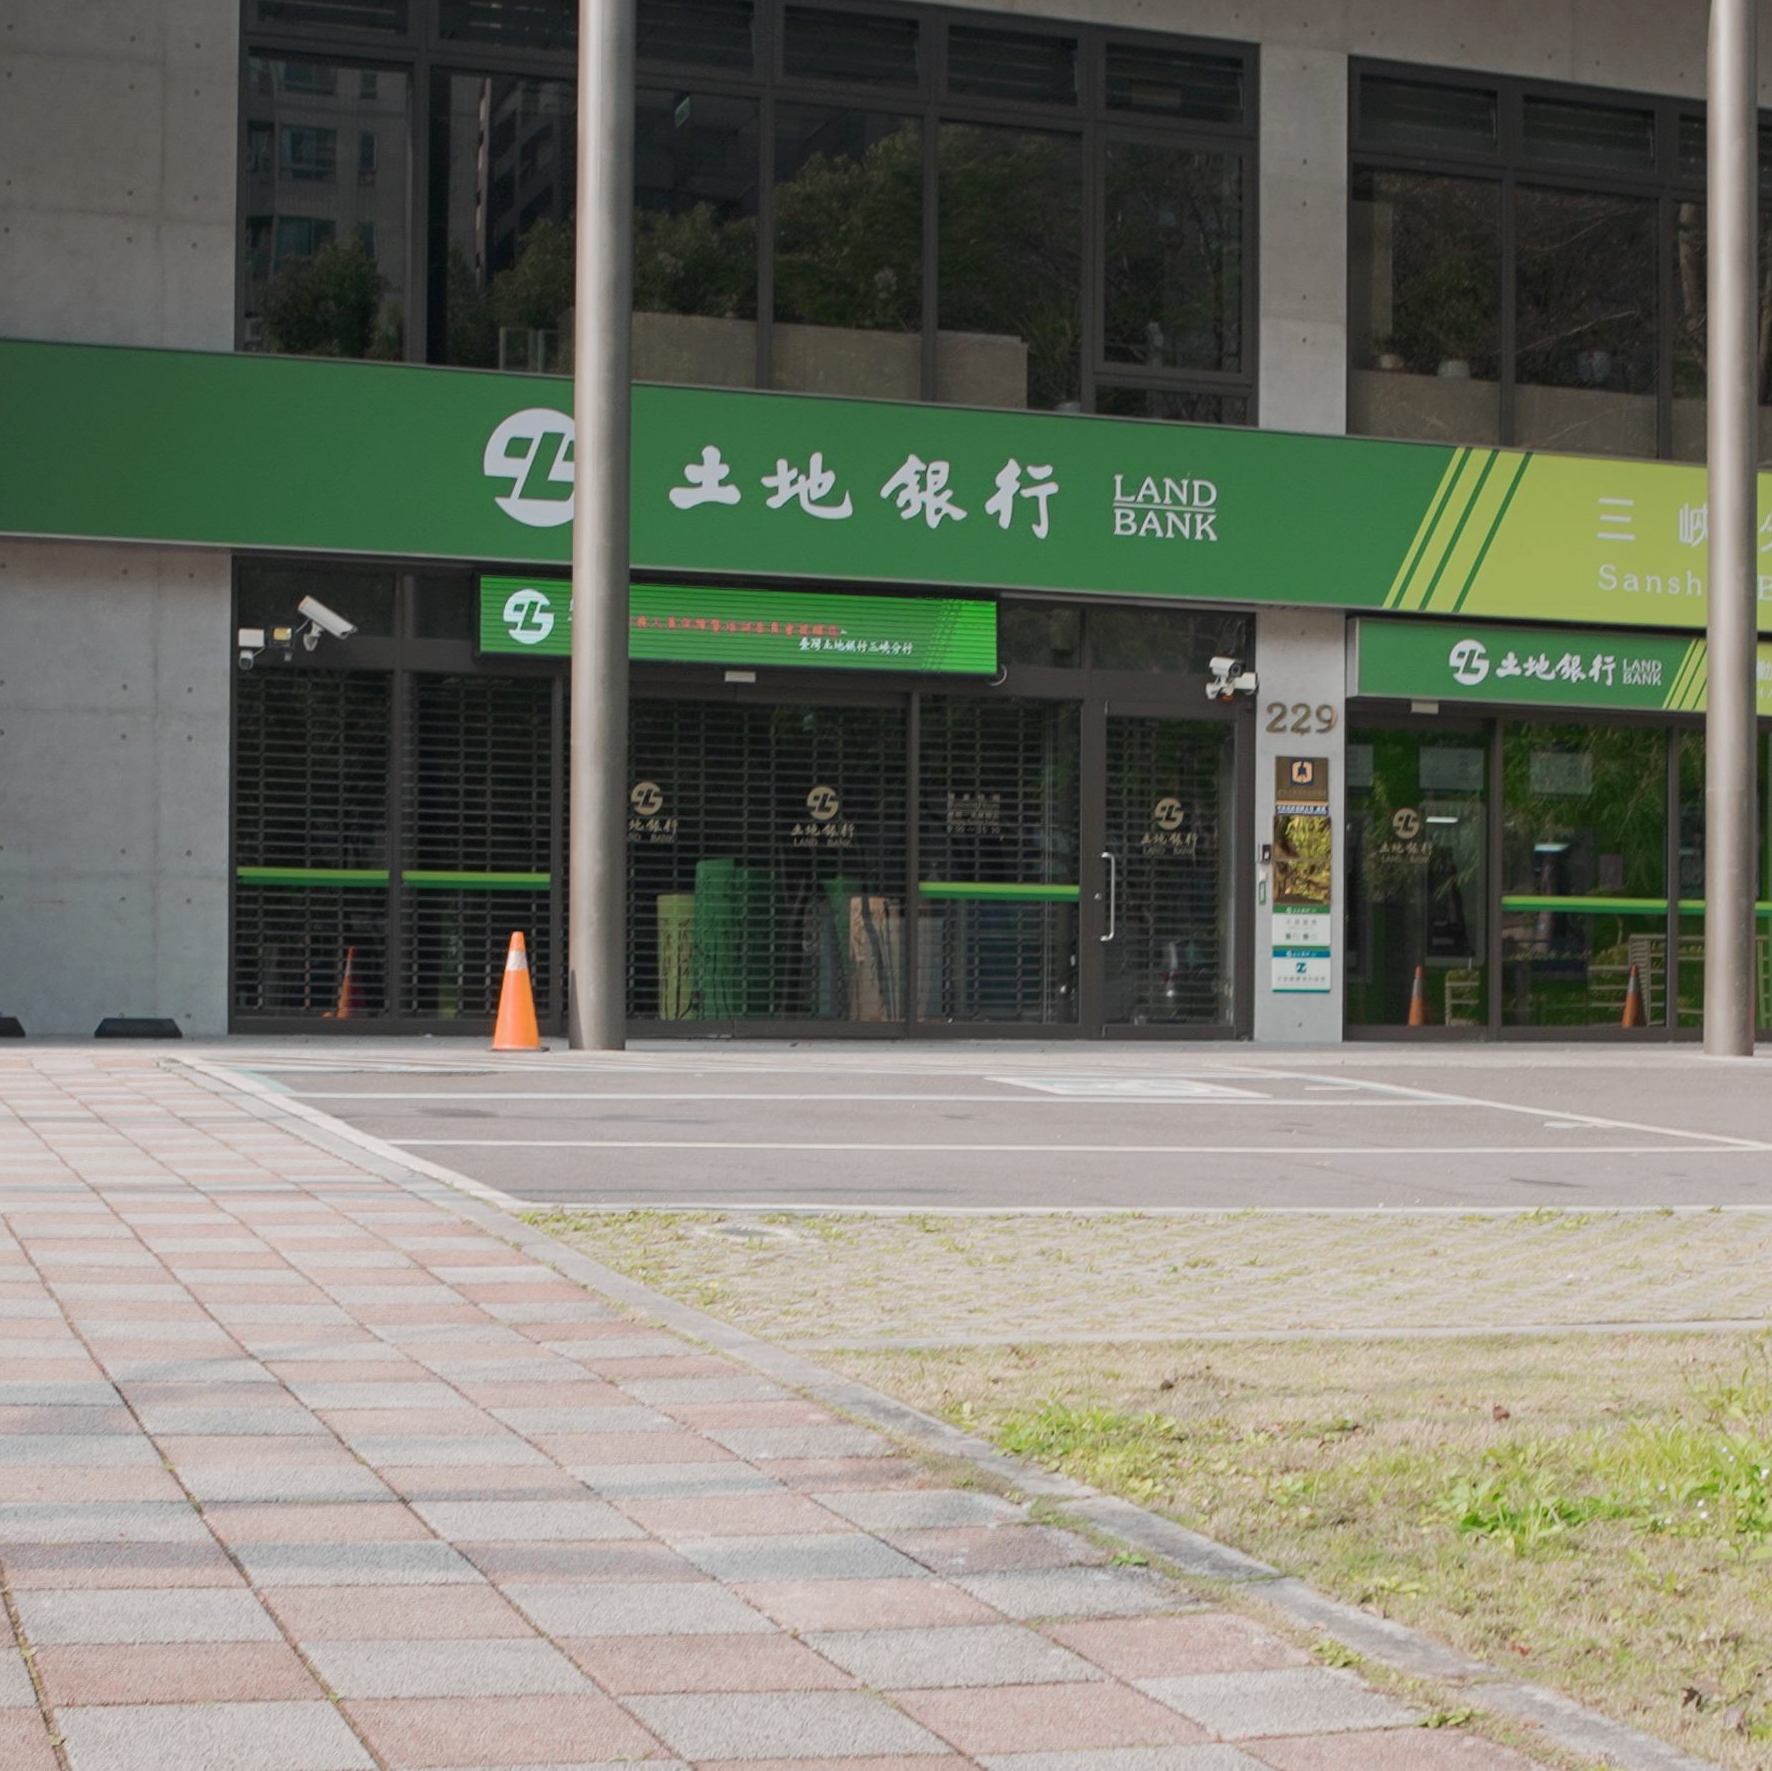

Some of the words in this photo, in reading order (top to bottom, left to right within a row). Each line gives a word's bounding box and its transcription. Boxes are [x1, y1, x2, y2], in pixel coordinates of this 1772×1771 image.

[668, 444, 1060, 540] 土地銀行
[1114, 474, 1217, 507] LAND
[1113, 507, 1218, 542] BANK
[1597, 563, 1705, 597] Sansh
[1495, 651, 1617, 686] 土地銀行
[1622, 658, 1663, 673] LAND
[1622, 671, 1662, 686] BANK
[1266, 701, 1338, 736] 229
